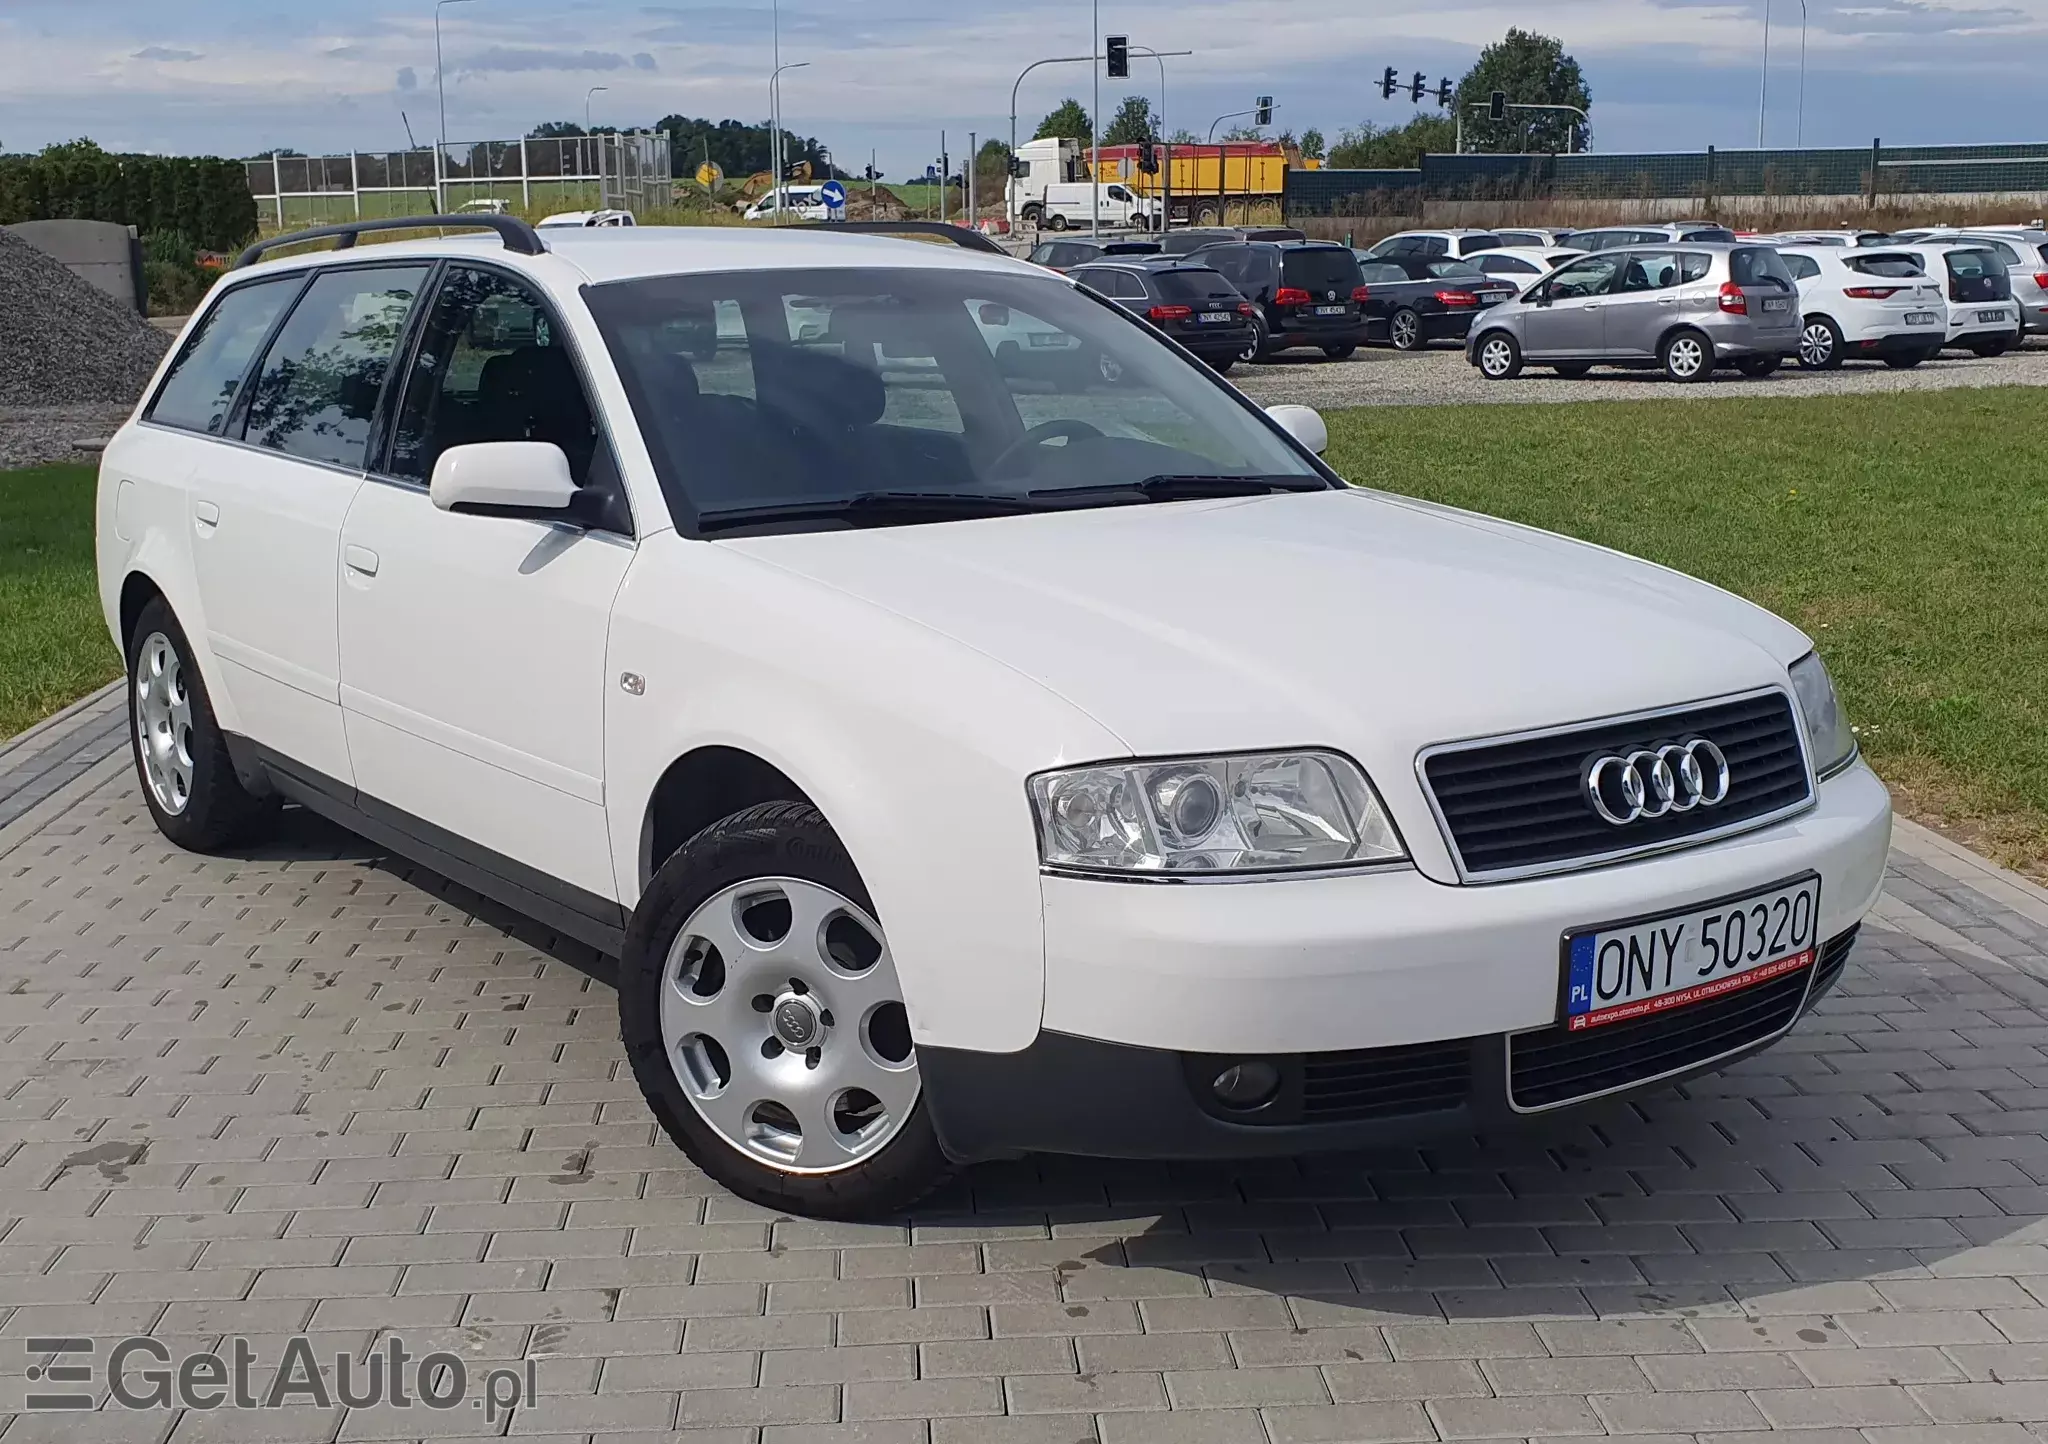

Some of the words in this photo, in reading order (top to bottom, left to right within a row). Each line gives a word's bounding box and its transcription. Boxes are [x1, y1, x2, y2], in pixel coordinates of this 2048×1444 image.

[1596, 924, 1685, 1000] ONY
[1697, 889, 1811, 976] 50320
[1571, 984, 1588, 1003] PL
[1590, 1002, 1651, 1023] autoexpo.otomoto.pl
